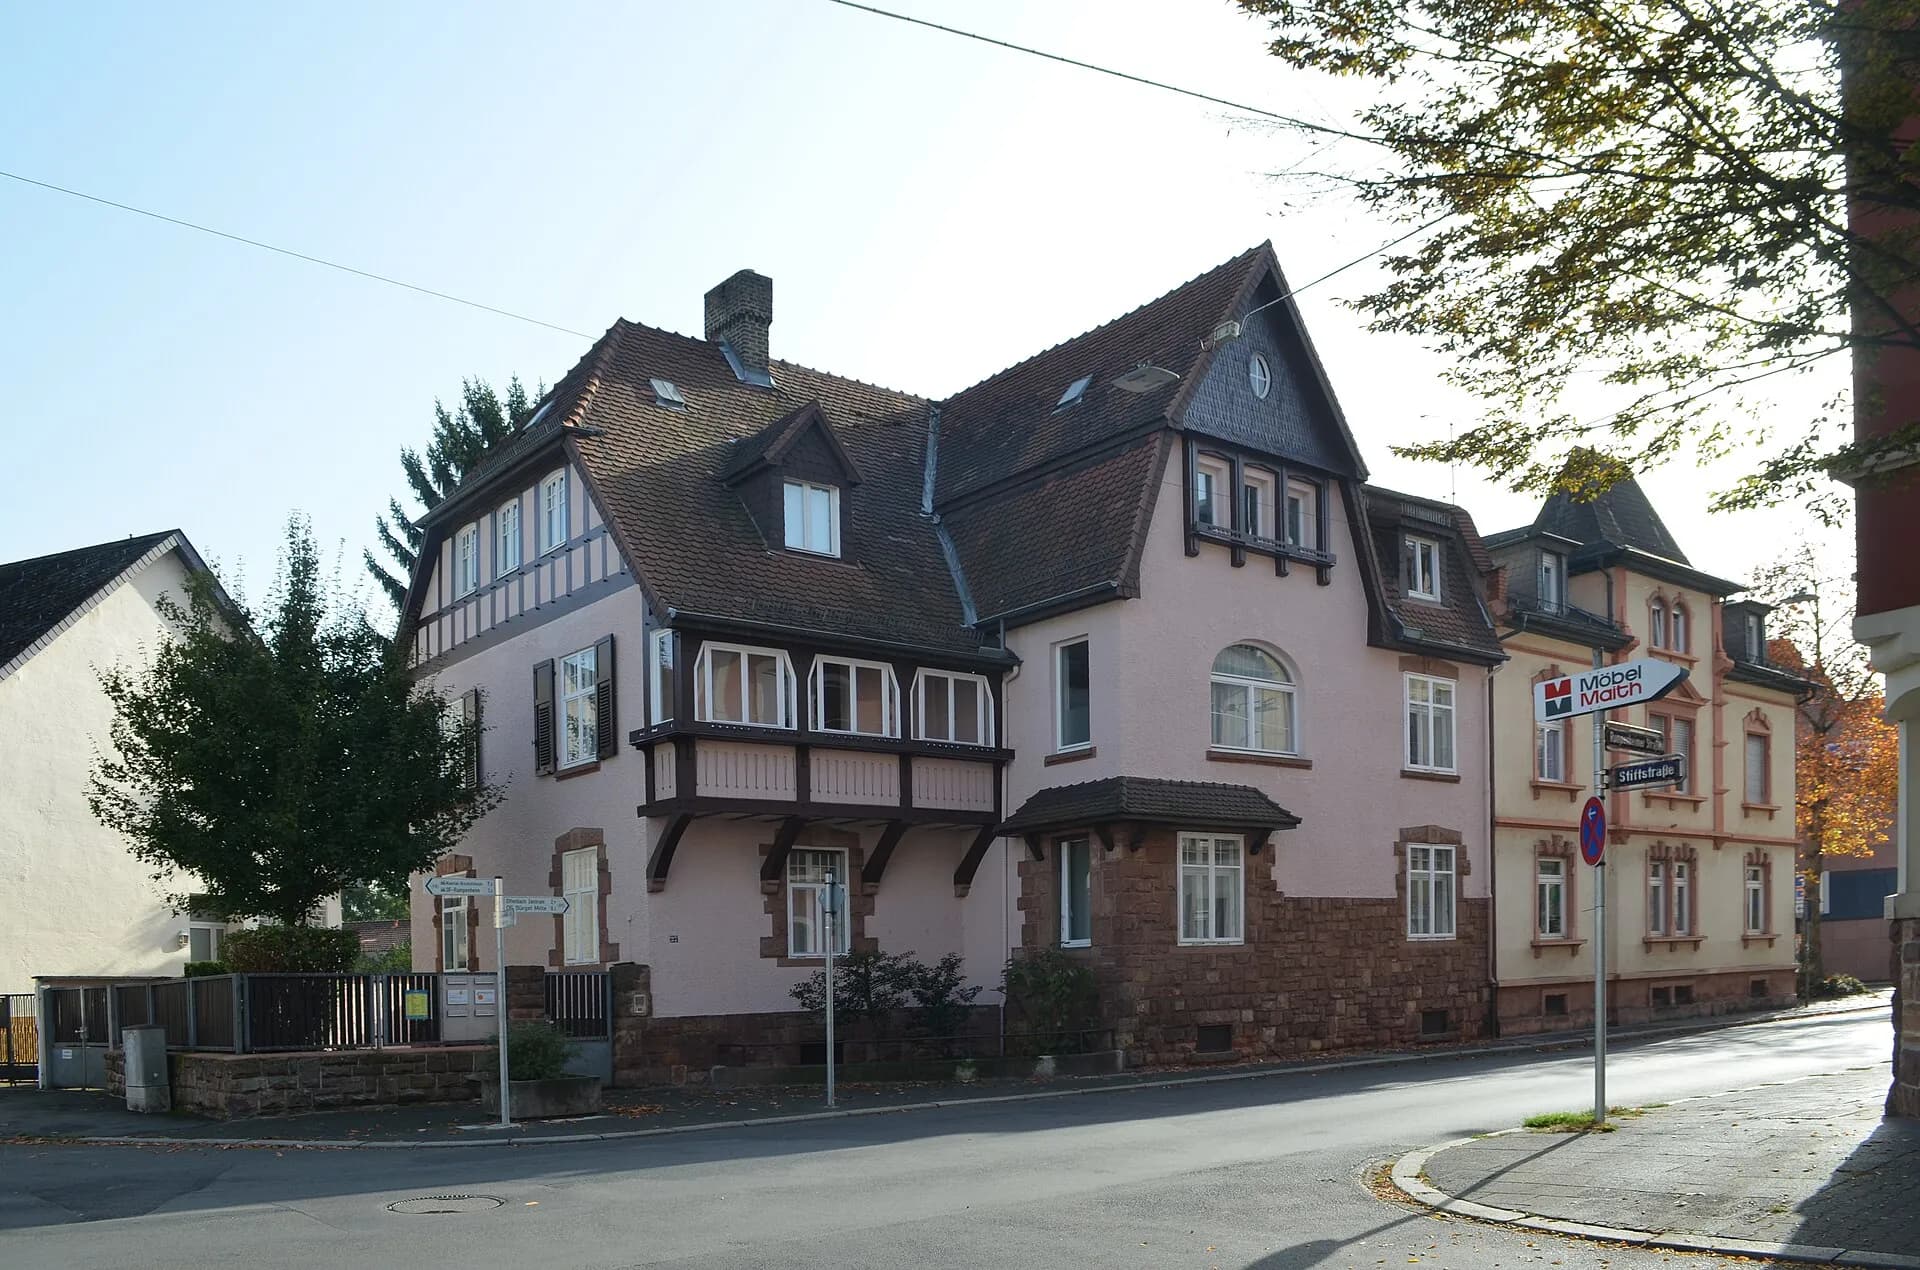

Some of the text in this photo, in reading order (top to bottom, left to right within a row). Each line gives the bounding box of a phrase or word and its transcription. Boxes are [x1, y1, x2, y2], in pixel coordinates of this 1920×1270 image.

[1580, 665, 1642, 692] Möbel
[1580, 682, 1642, 707] Maith
[1619, 764, 1675, 783] Stiftstraße
